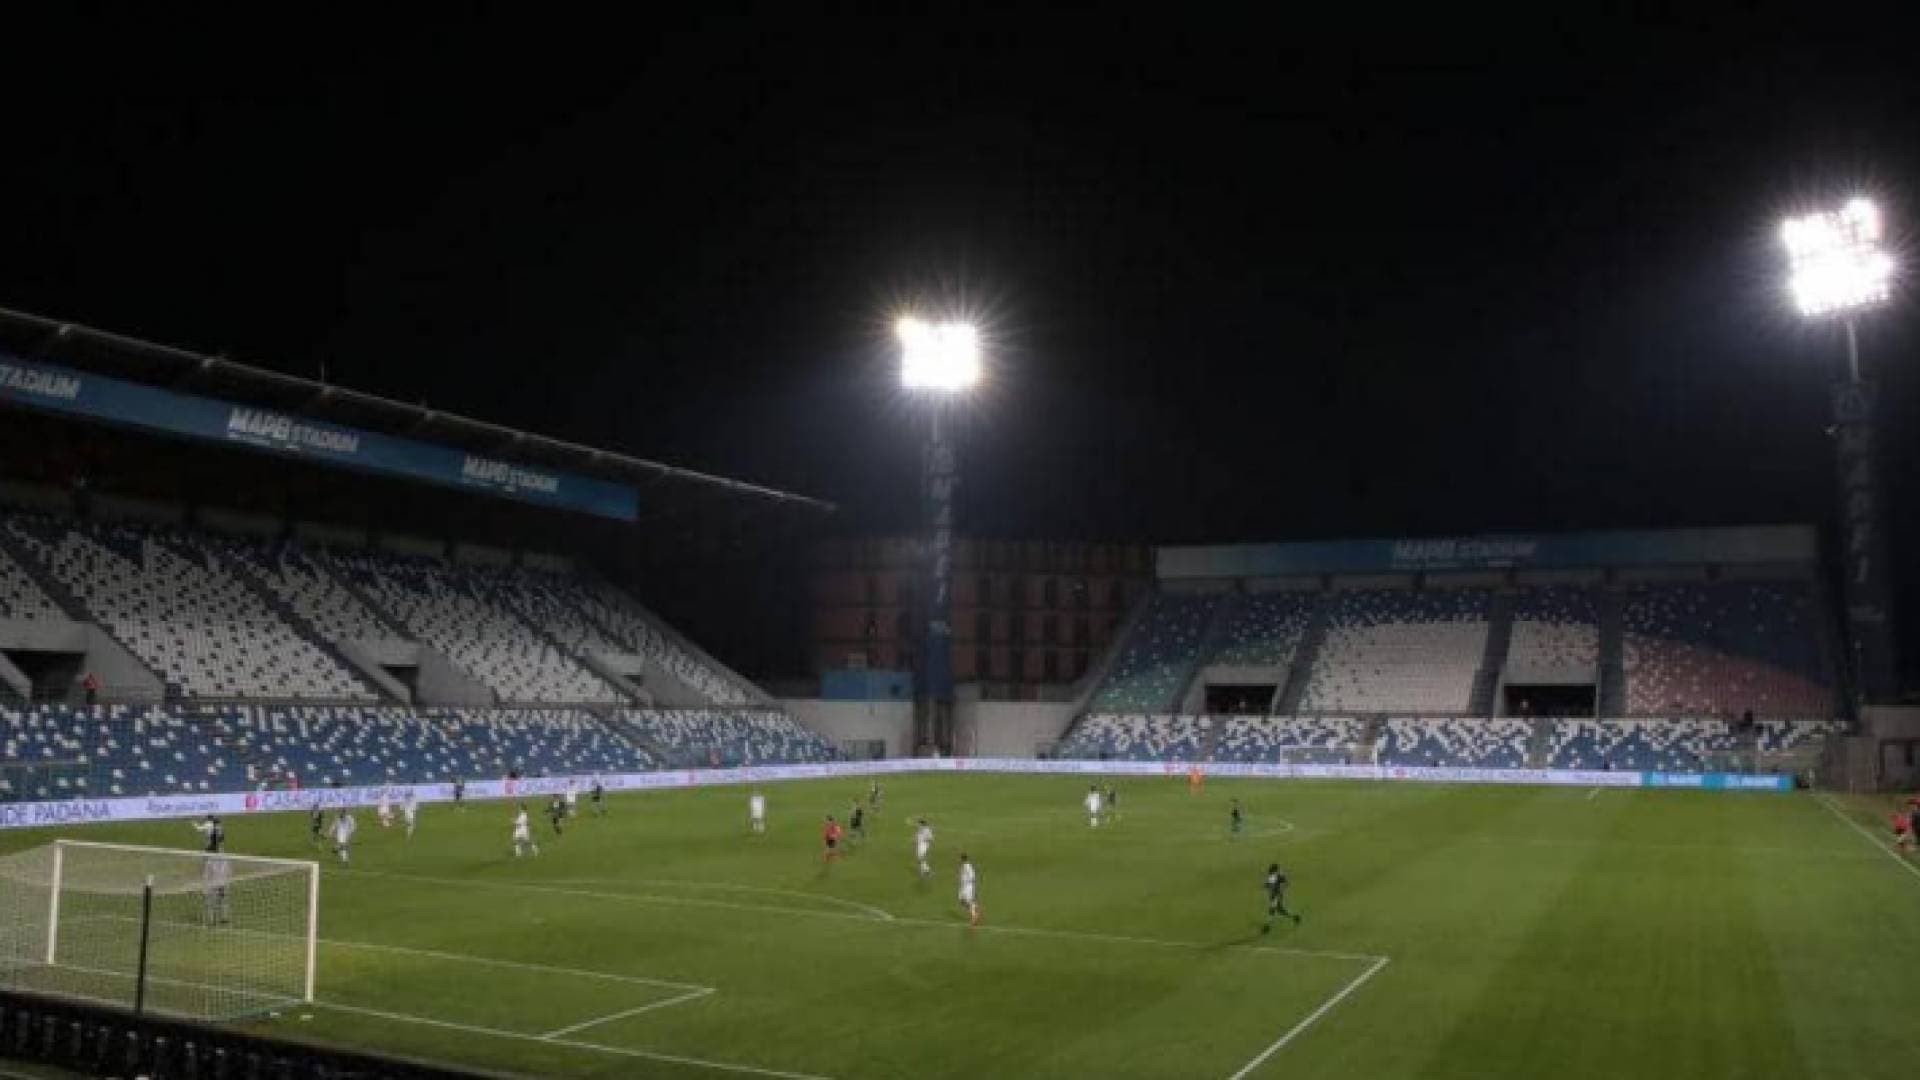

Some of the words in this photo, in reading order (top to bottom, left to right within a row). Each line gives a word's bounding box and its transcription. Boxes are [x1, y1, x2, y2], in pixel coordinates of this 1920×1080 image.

[228, 406, 291, 440] MAPEI
[290, 423, 359, 452] STADIUM
[34, 801, 109, 822] PADANA
